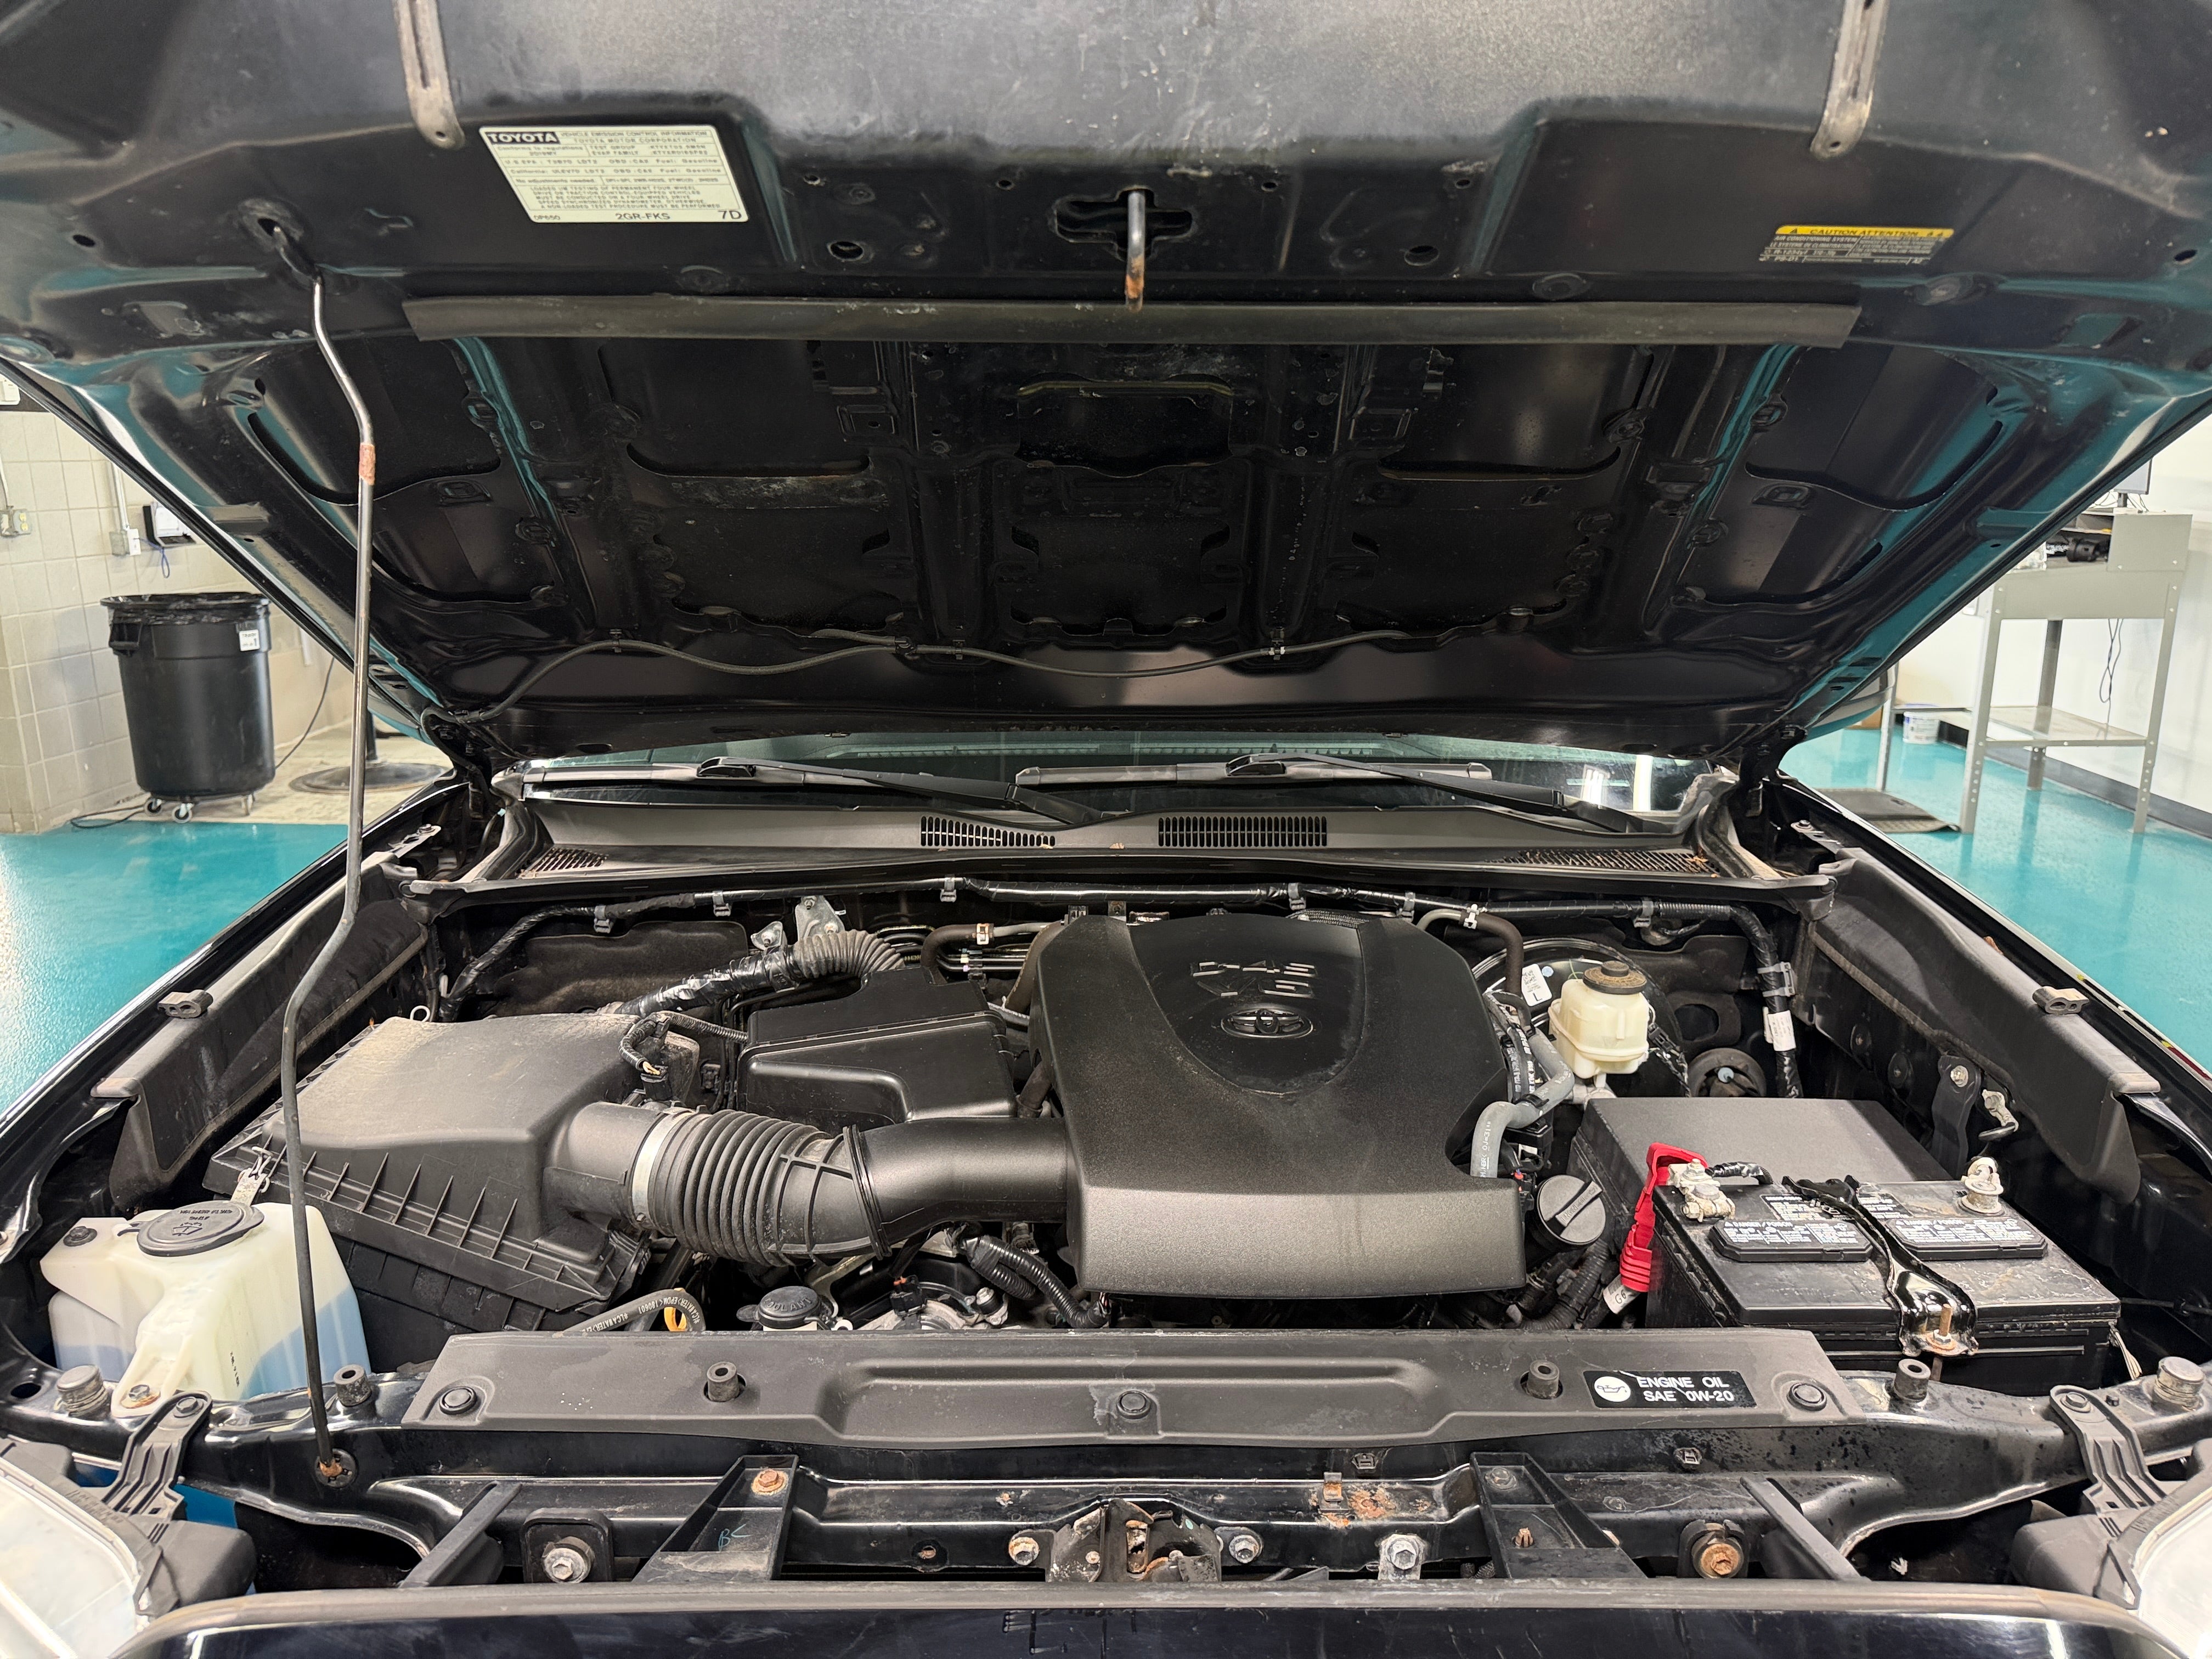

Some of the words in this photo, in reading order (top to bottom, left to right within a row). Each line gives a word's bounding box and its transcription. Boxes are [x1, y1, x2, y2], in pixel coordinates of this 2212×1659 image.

[487, 133, 558, 143] TOYOTA
[615, 212, 671, 221] 2GR-FKS
[718, 210, 742, 220] 7D
[1532, 992, 1543, 1002] L
[763, 1296, 812, 1312] COOLANT
[1637, 1376, 1695, 1389] ENGINE
[1702, 1376, 1730, 1389] OIL
[1643, 1390, 1677, 1402] SAE
